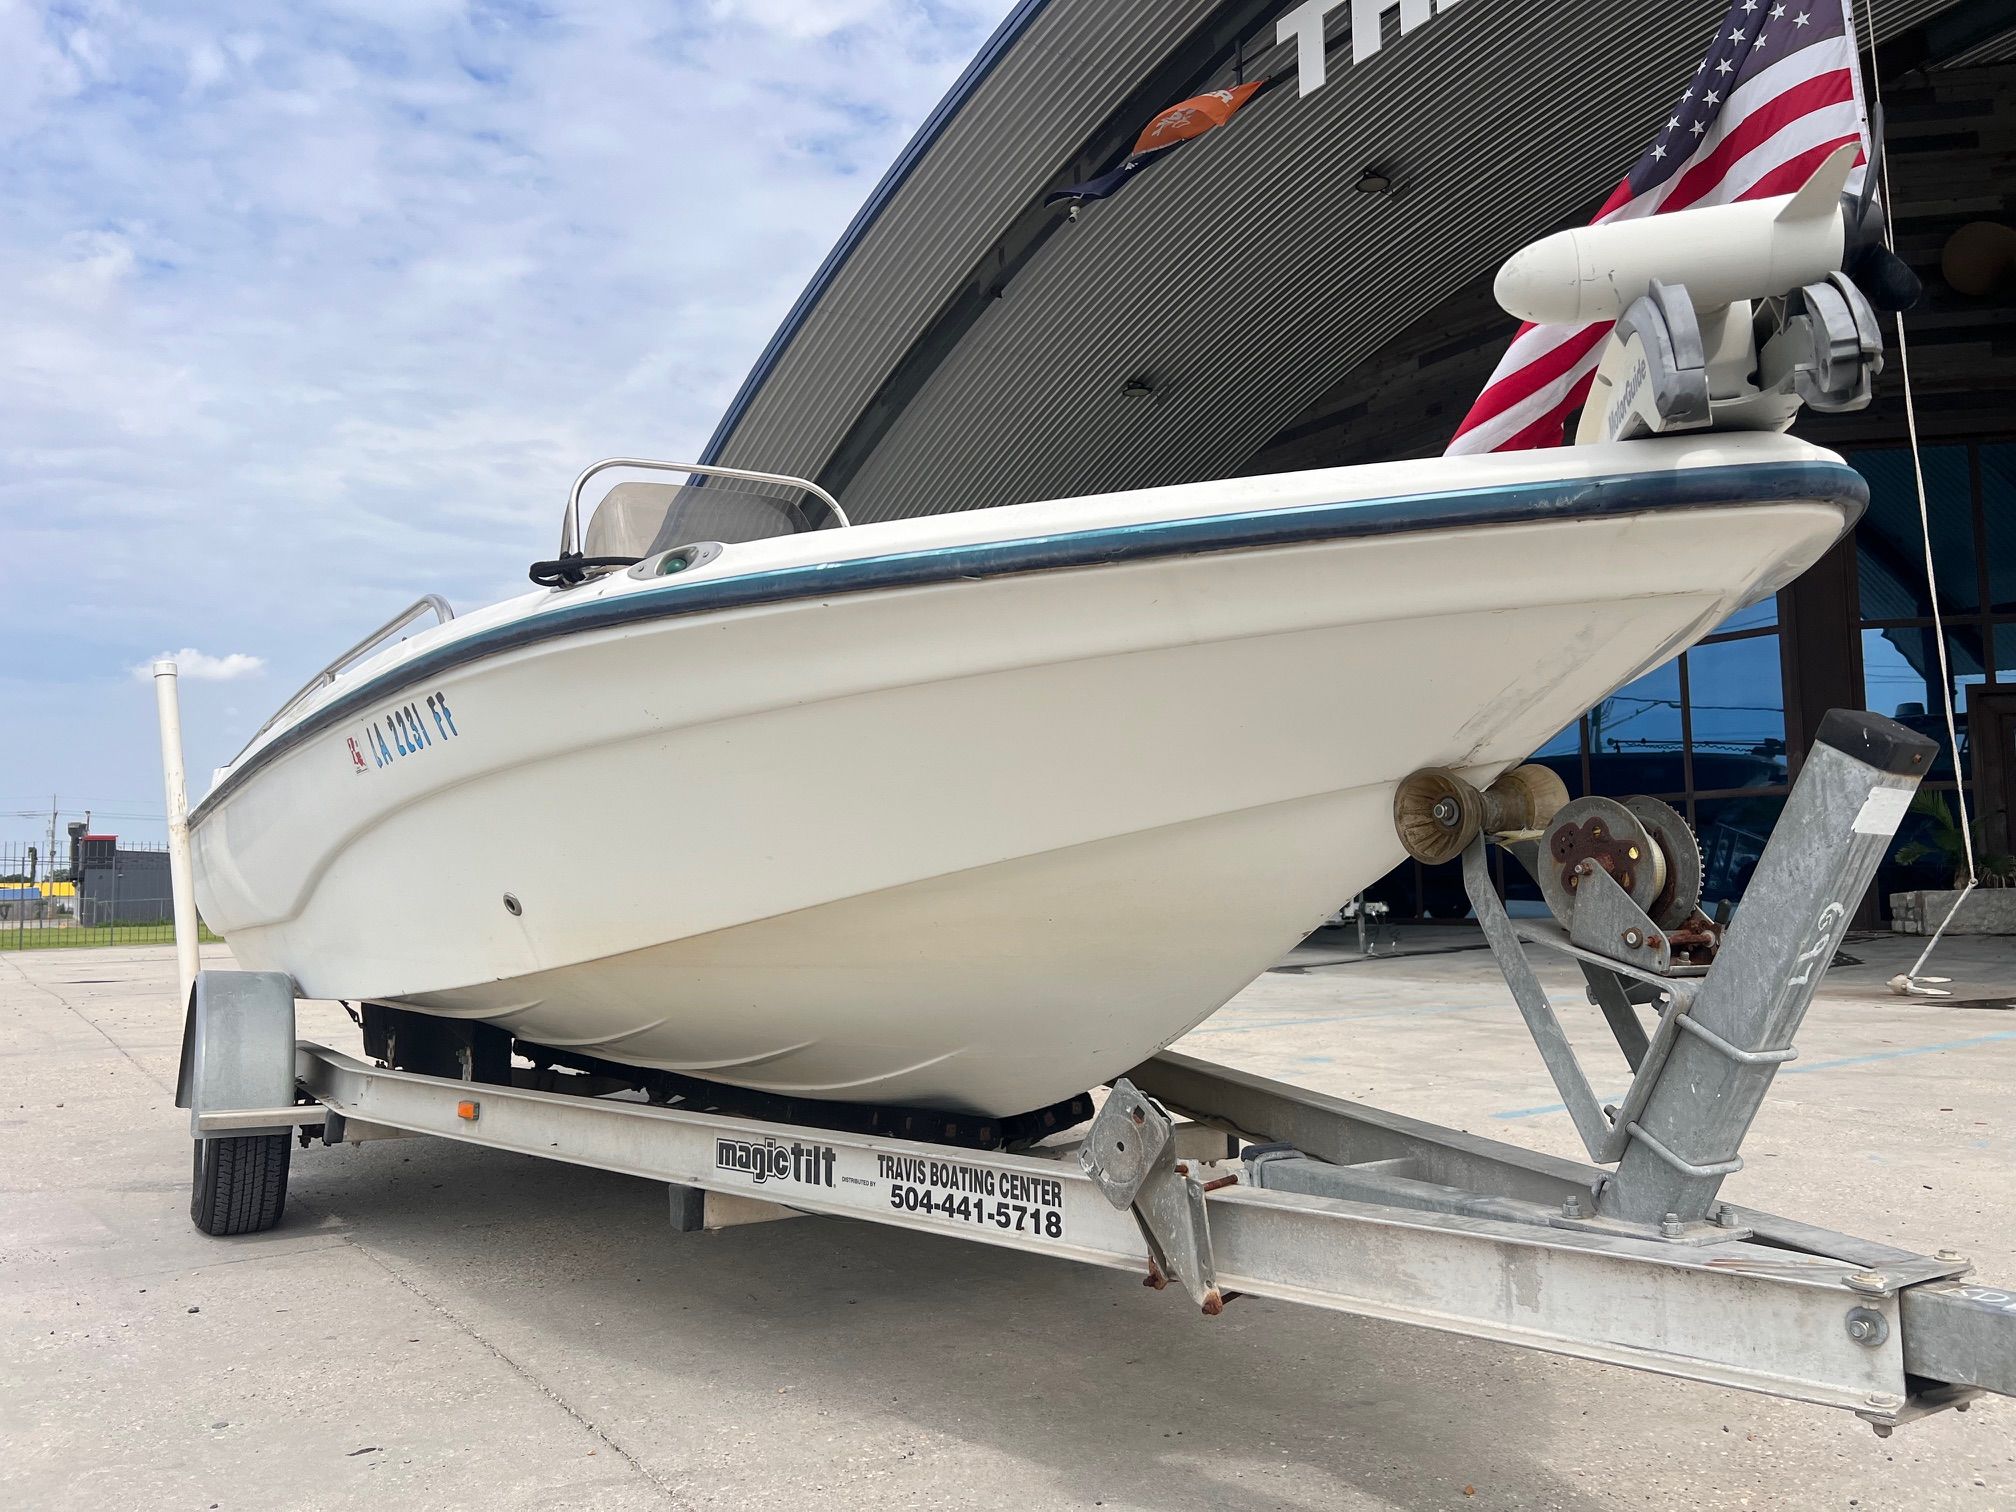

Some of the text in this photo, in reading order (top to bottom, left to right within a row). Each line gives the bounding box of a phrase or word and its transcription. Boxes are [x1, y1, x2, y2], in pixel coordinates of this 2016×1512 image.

[1608, 359, 1647, 440] MotorGuide
[366, 722, 393, 768] LA
[387, 703, 431, 756] 2231
[841, 1176, 869, 1186] DISTRIBUTED
[877, 1154, 1062, 1207] TRAVIS BOATING CENTER
[890, 1184, 1062, 1238] 504-441-5718
